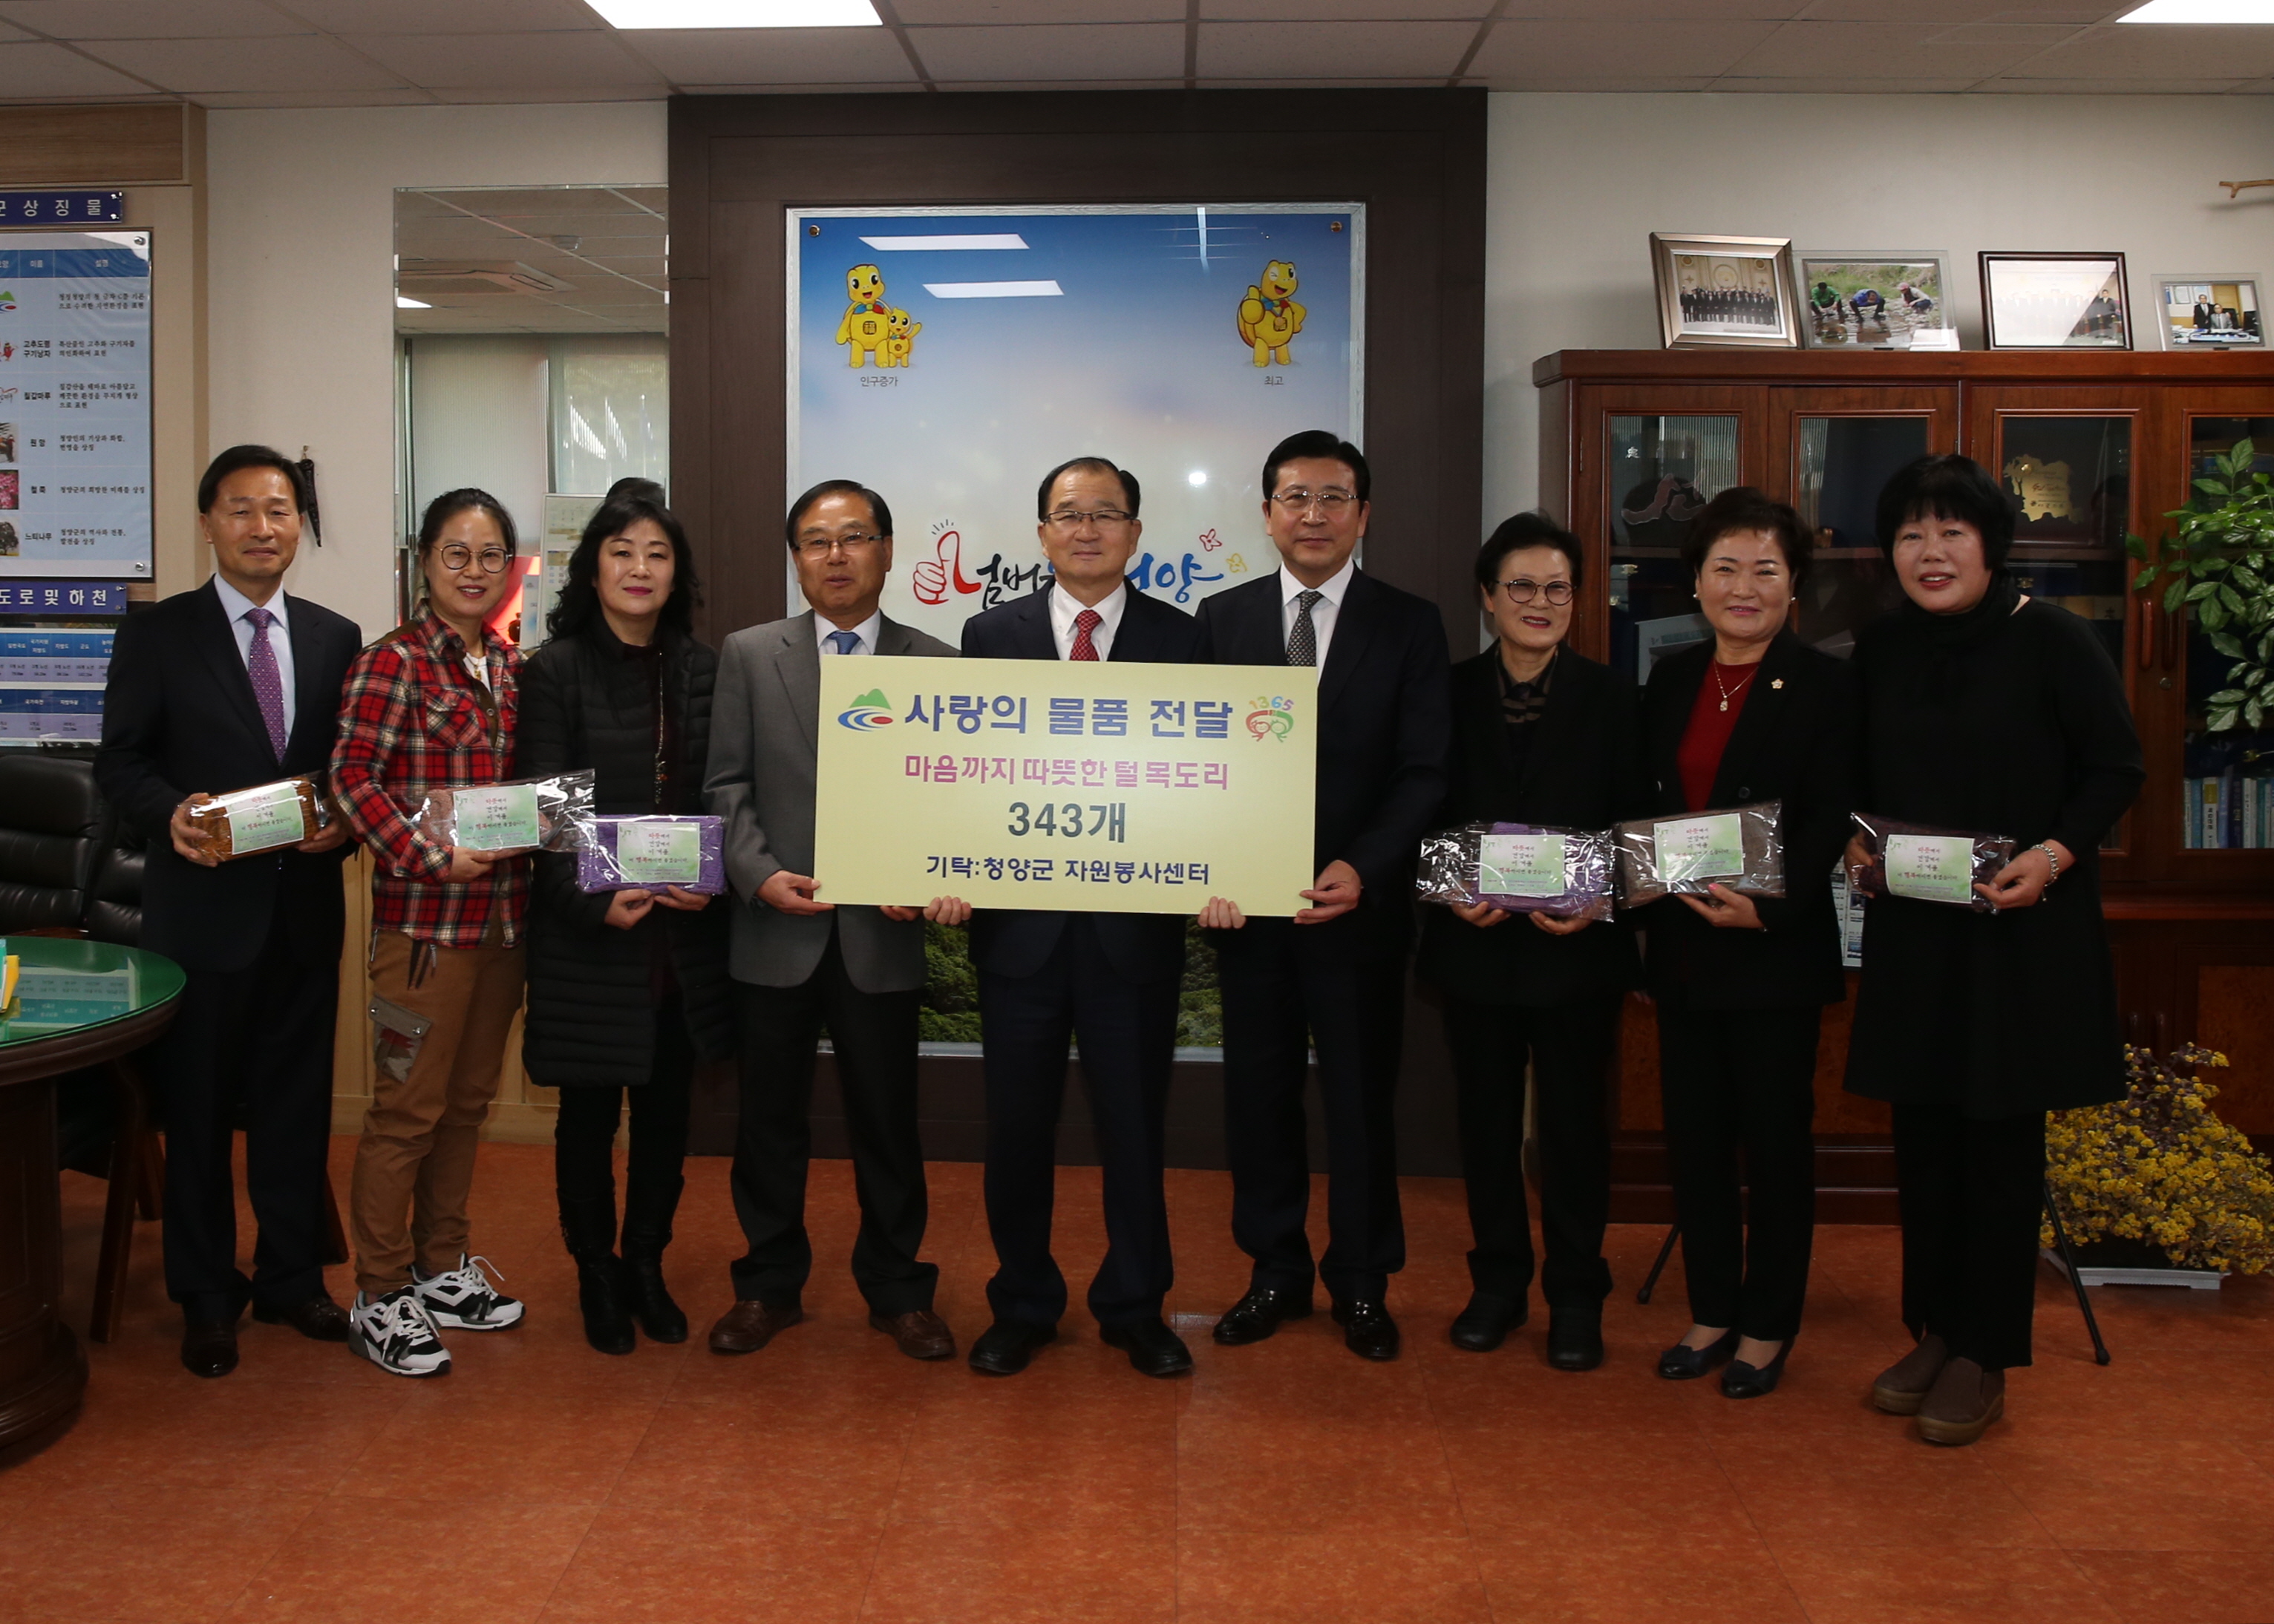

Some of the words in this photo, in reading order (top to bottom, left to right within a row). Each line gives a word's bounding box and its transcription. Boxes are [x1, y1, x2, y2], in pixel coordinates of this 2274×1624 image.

[860, 376, 898, 387] 인구증가
[1264, 376, 1284, 387] 최고
[24, 533, 52, 541] 느티나무
[905, 695, 1027, 734] 사랑의
[1048, 696, 1128, 736] 물품
[1150, 698, 1233, 739] 전달
[1249, 695, 1295, 711] 1365
[904, 755, 1016, 785] 마음까지
[1022, 757, 1108, 787] 따뜻한
[1007, 802, 1126, 843] 343개
[1065, 860, 1209, 885] 자원봉사센터
